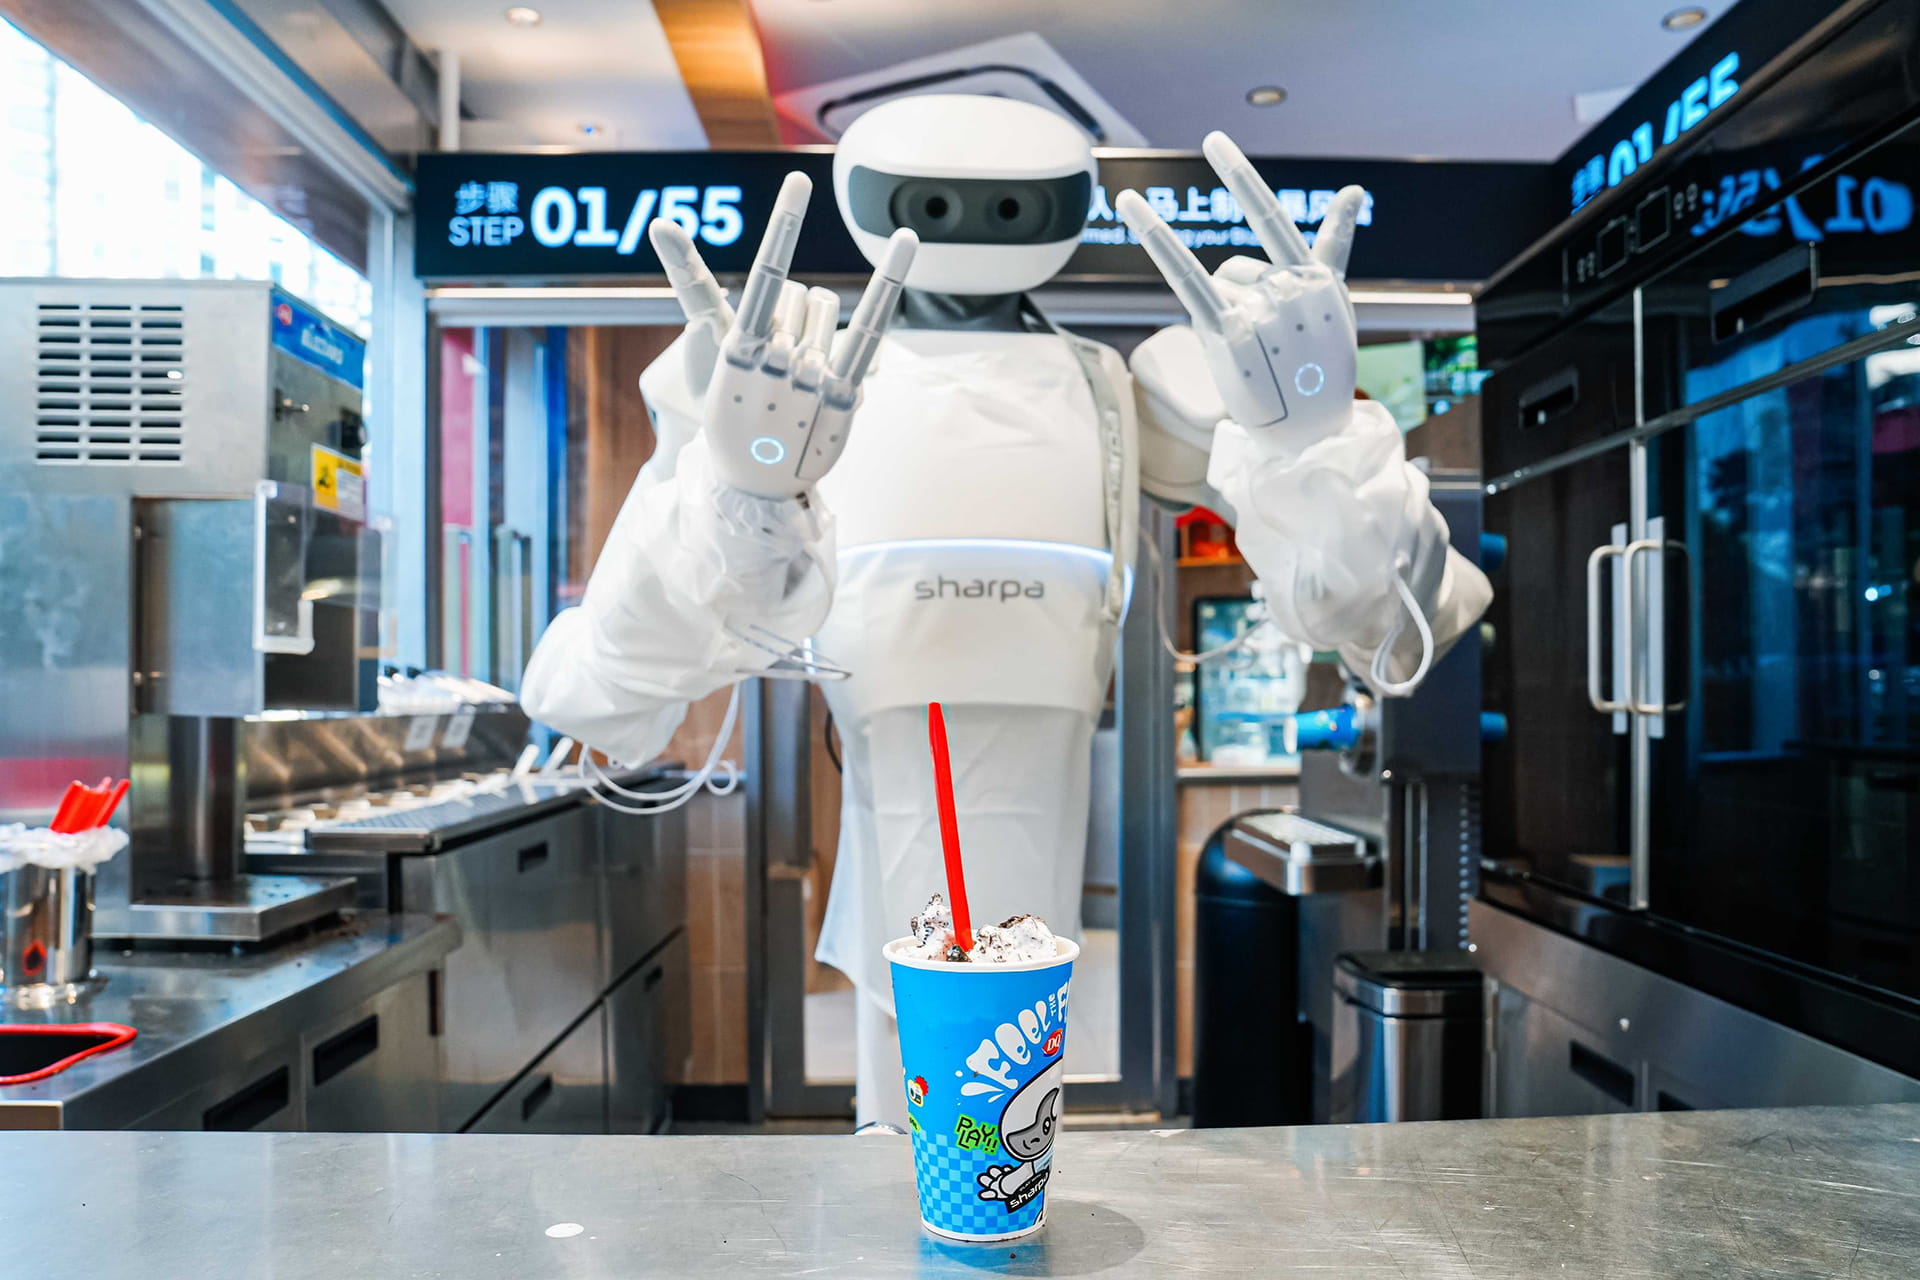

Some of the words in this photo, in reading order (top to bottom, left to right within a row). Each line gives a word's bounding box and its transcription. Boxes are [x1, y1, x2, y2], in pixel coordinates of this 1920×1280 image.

[454, 181, 519, 214] 步骤
[449, 216, 524, 247] STEP
[531, 186, 743, 254] 01/55
[914, 575, 1044, 602] sharpa
